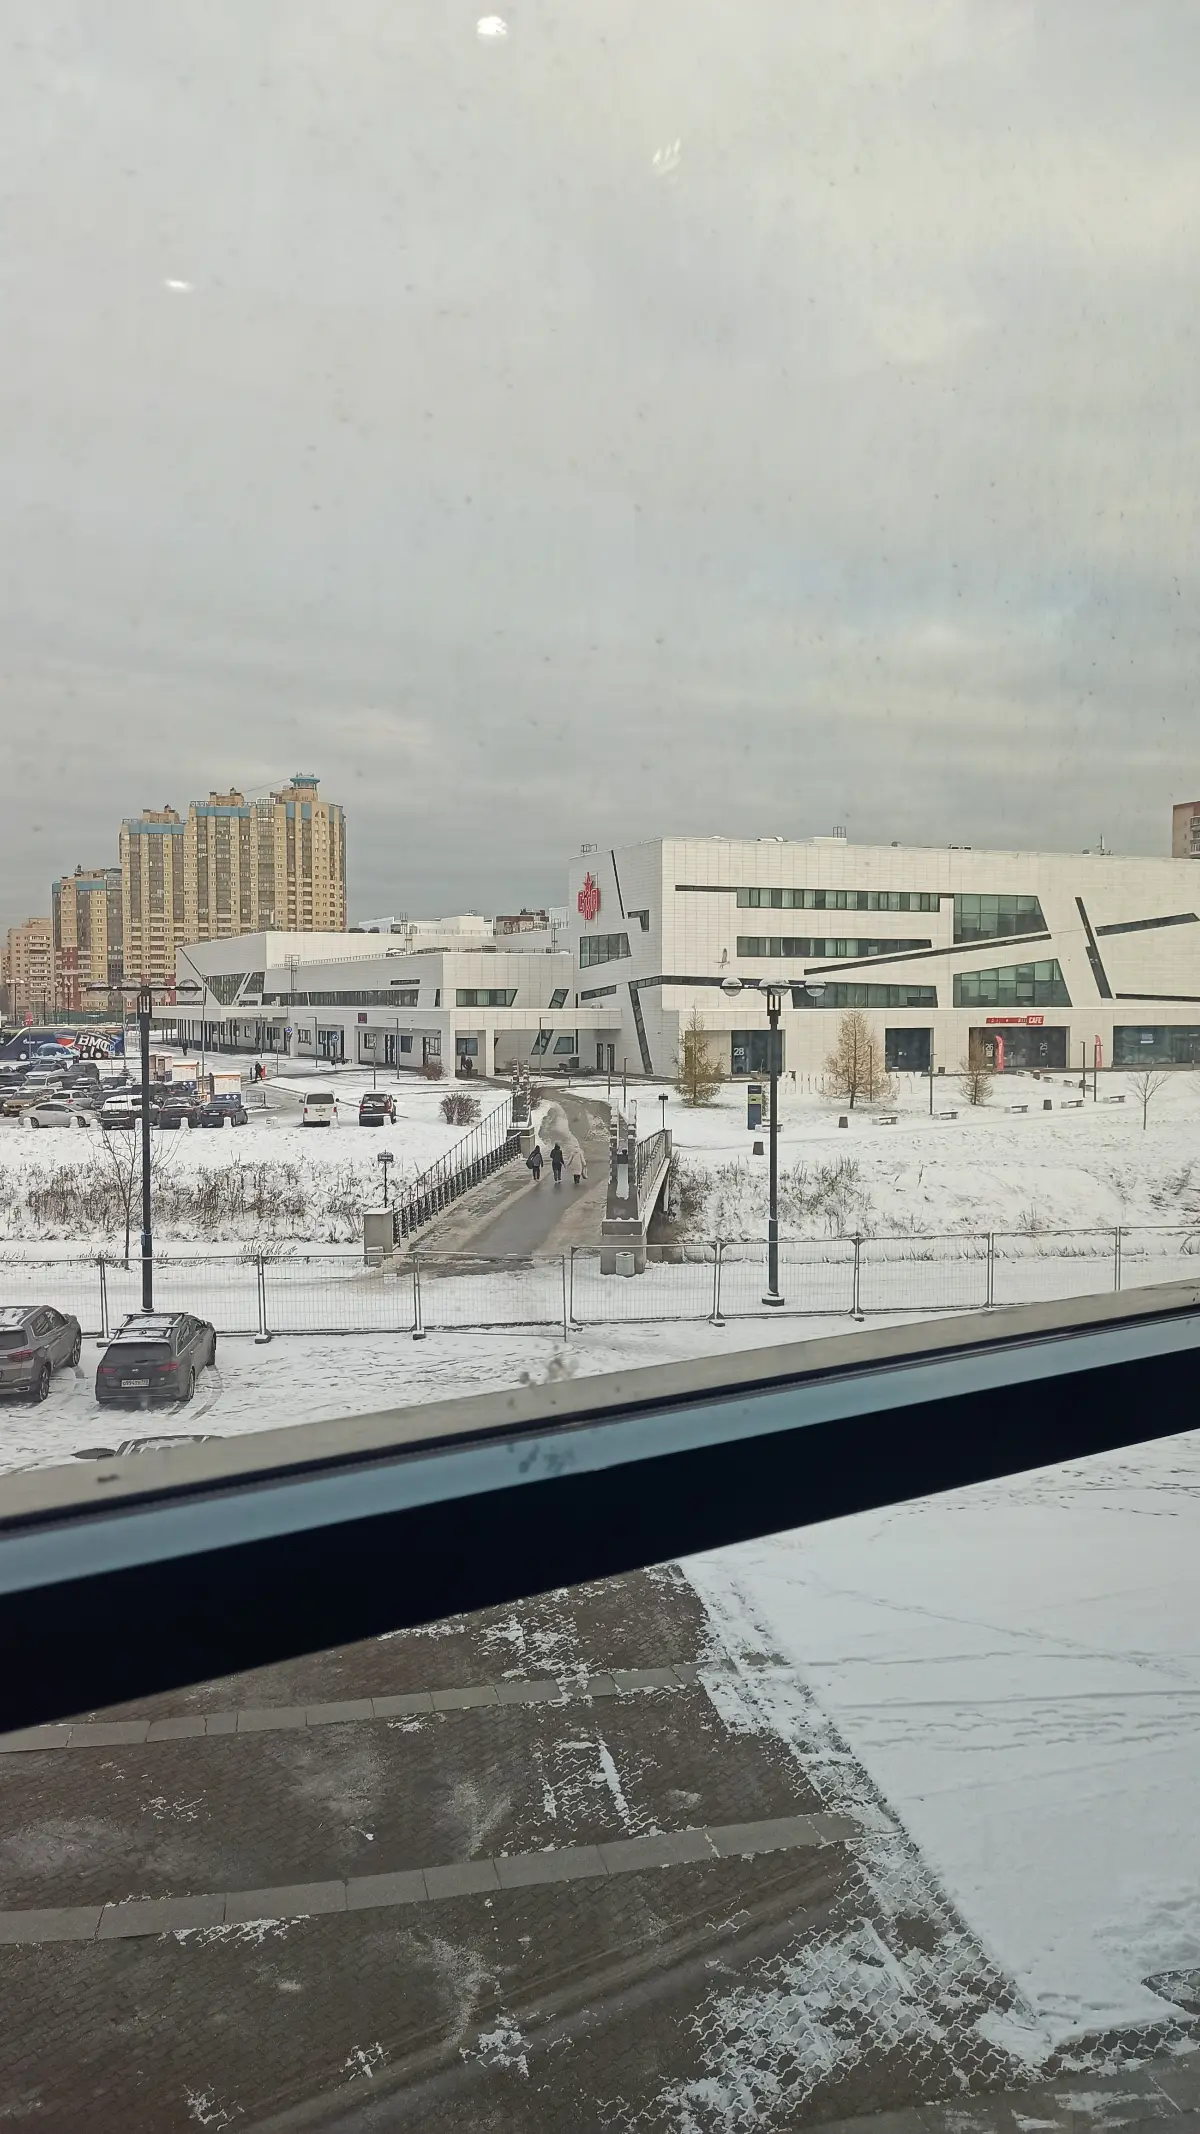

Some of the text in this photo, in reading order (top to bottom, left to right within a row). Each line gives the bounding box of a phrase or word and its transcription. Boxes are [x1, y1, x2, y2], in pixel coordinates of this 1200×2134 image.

[1028, 1016, 1043, 1024] CAFE
[985, 1043, 994, 1051] 26
[1039, 1042, 1048, 1051] 25
[733, 1047, 745, 1056] 28
